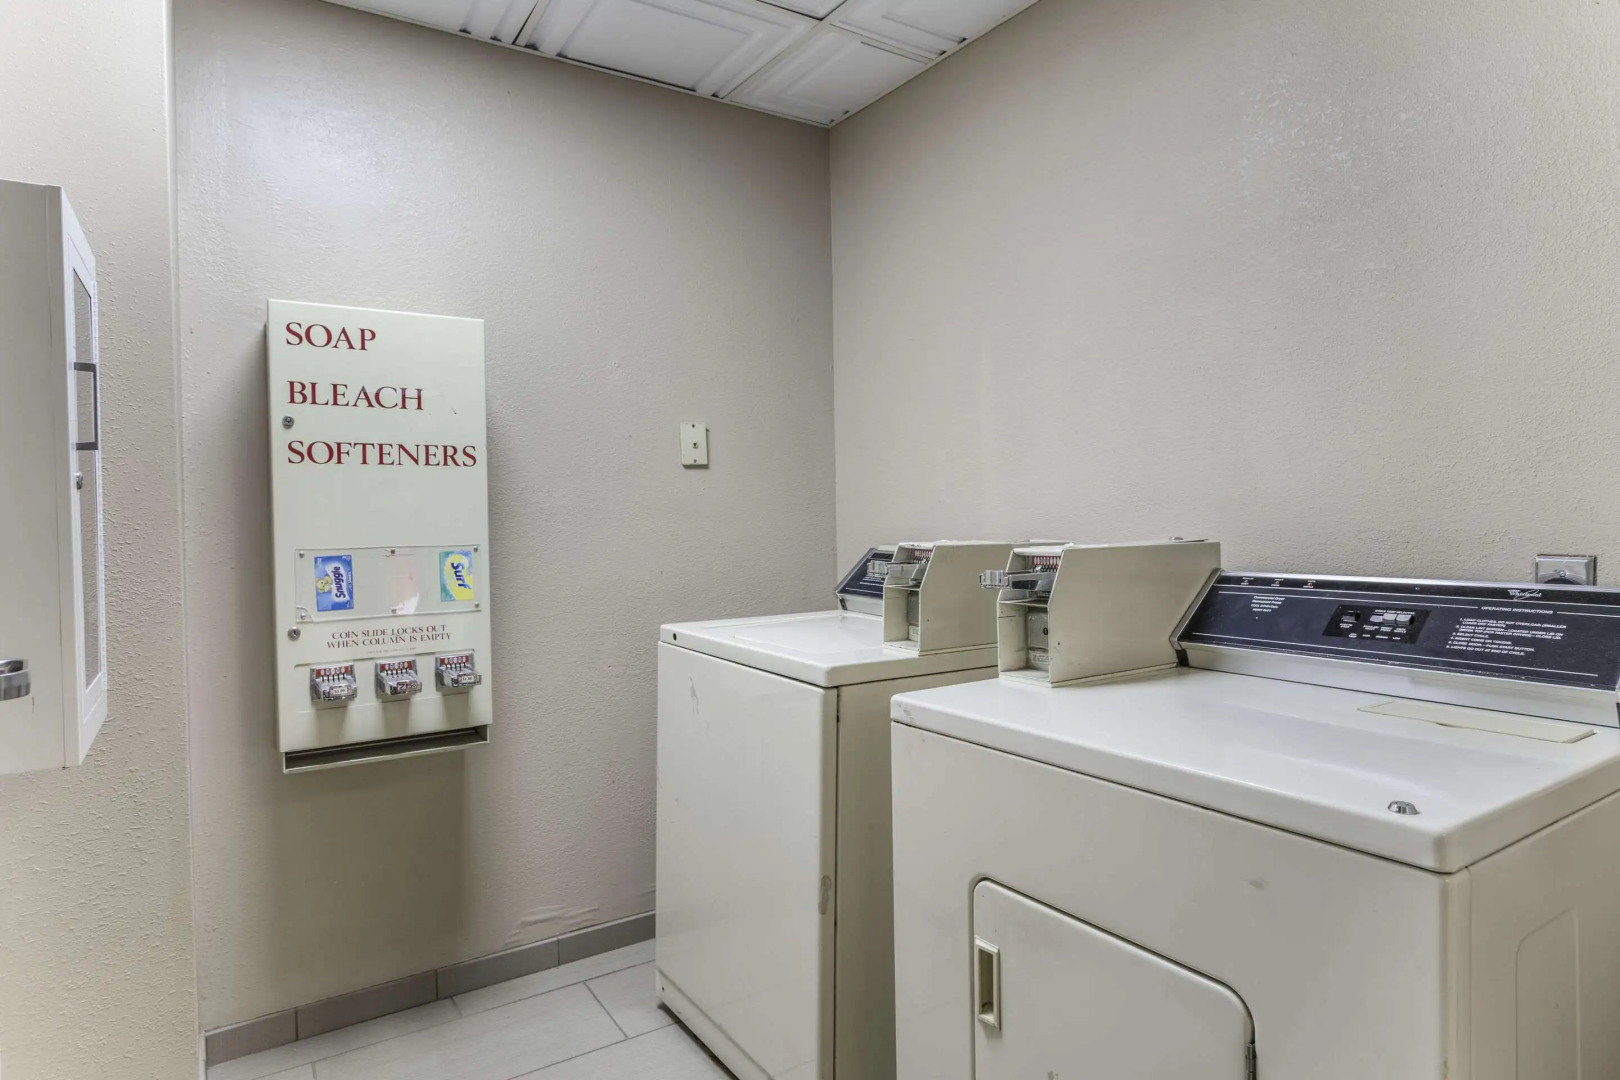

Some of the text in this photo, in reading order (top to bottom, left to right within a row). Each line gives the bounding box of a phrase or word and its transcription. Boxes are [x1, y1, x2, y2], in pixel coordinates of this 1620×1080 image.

[285, 321, 377, 351] SOAP
[287, 380, 424, 410] BLEACH
[287, 440, 477, 467] SOFTENERS
[331, 566, 346, 599] Snuggle
[450, 562, 472, 590] Surf
[326, 632, 453, 649] WHEN COLUMN IS EMPTY
[331, 624, 447, 640] COIN SLIDE LOCKS OUT
